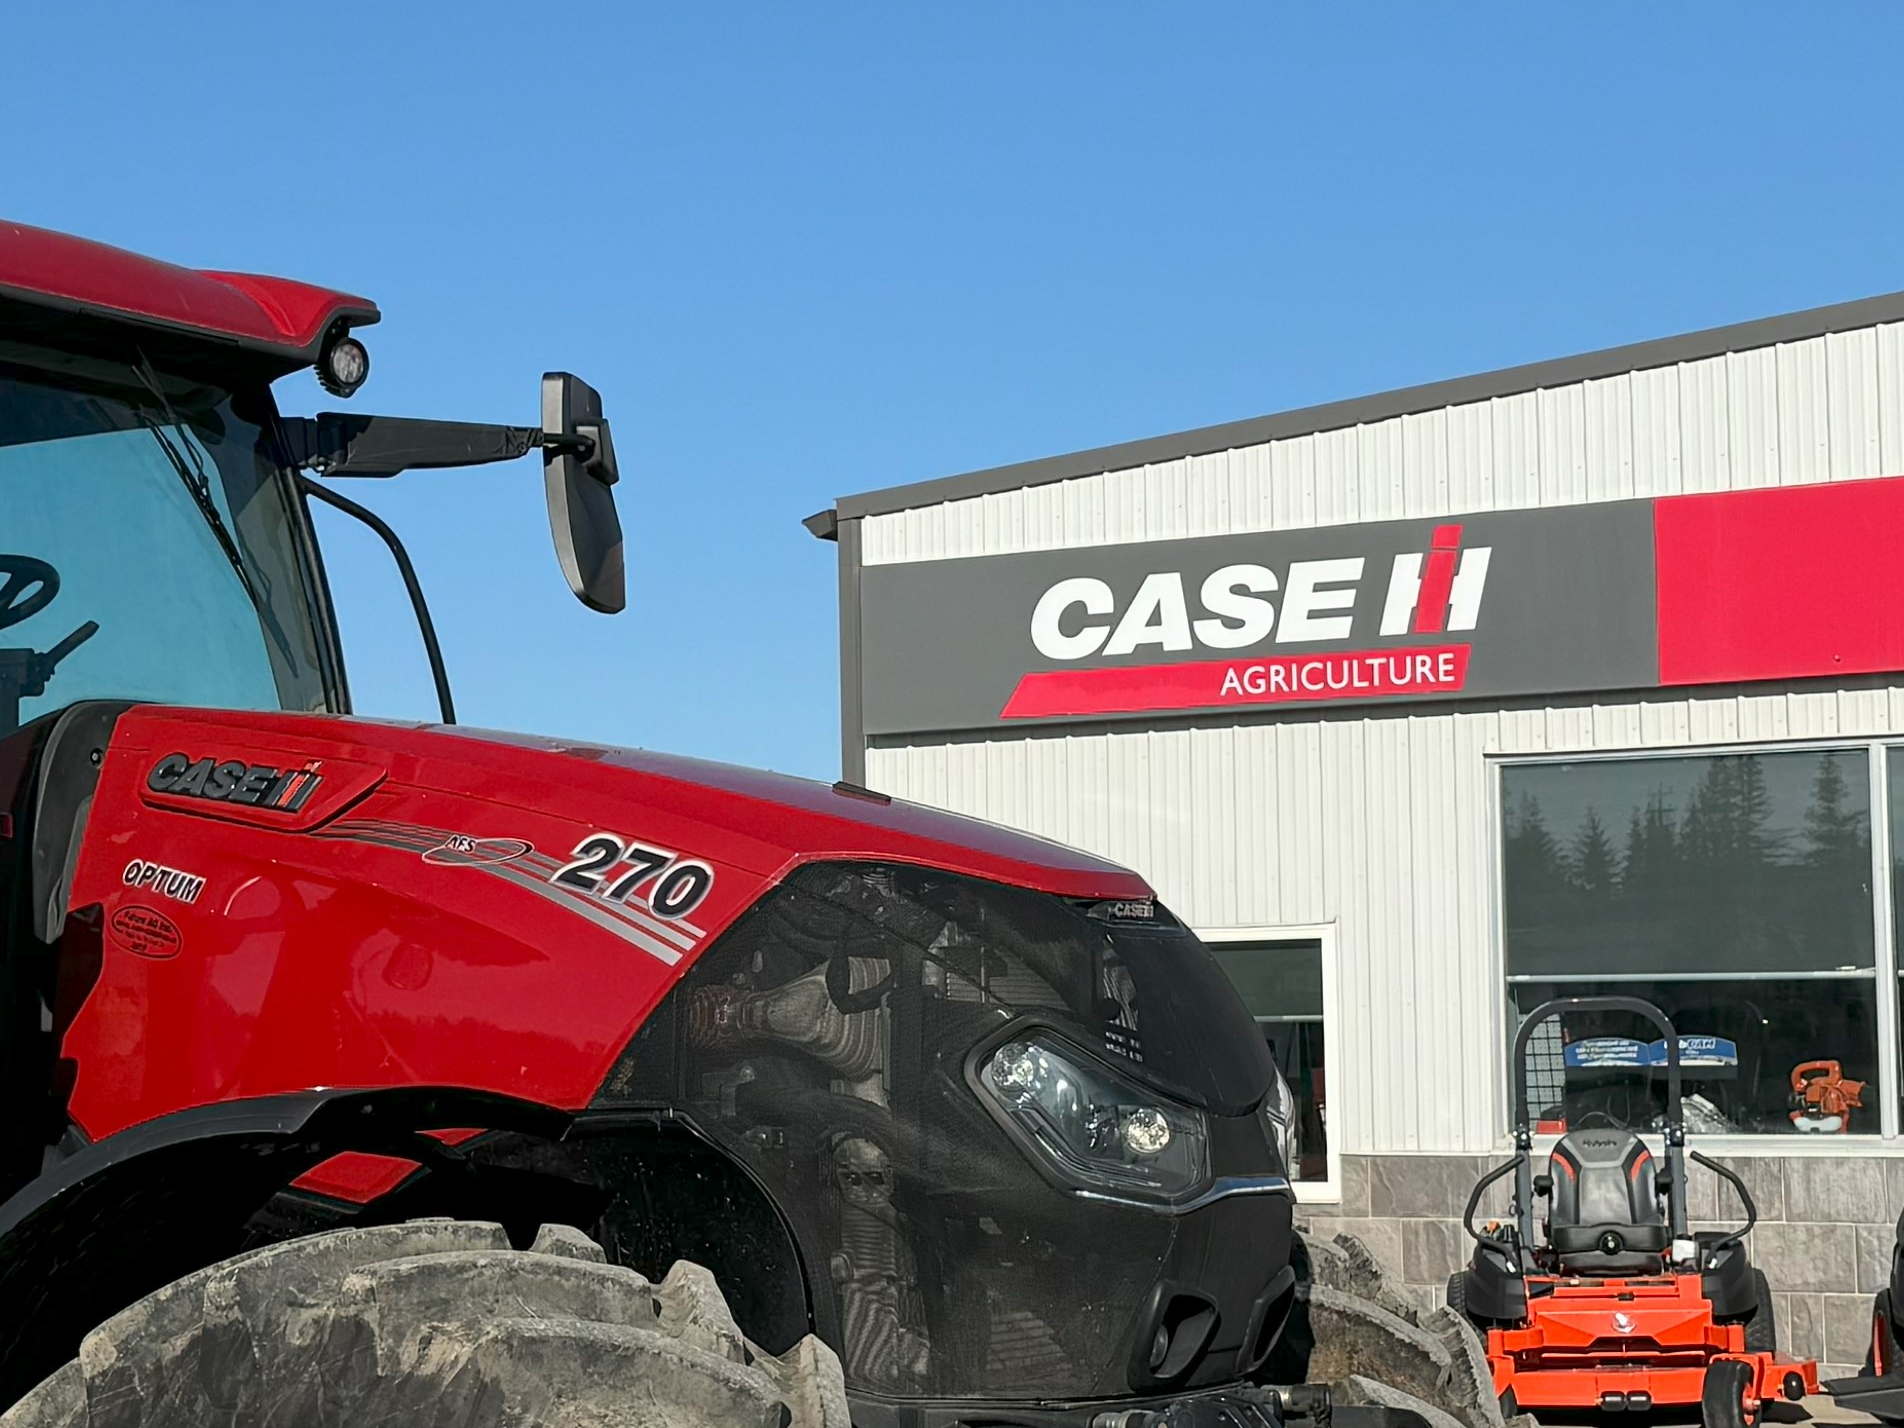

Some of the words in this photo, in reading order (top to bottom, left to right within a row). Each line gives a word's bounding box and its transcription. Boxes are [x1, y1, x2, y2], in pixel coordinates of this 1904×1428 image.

[1029, 556, 1365, 660] CASE
[1220, 652, 1456, 696] AGRICULTURE
[148, 752, 279, 804] CASE
[445, 834, 477, 854] AFS
[122, 858, 208, 905] OPTUM
[548, 832, 715, 921] 270
